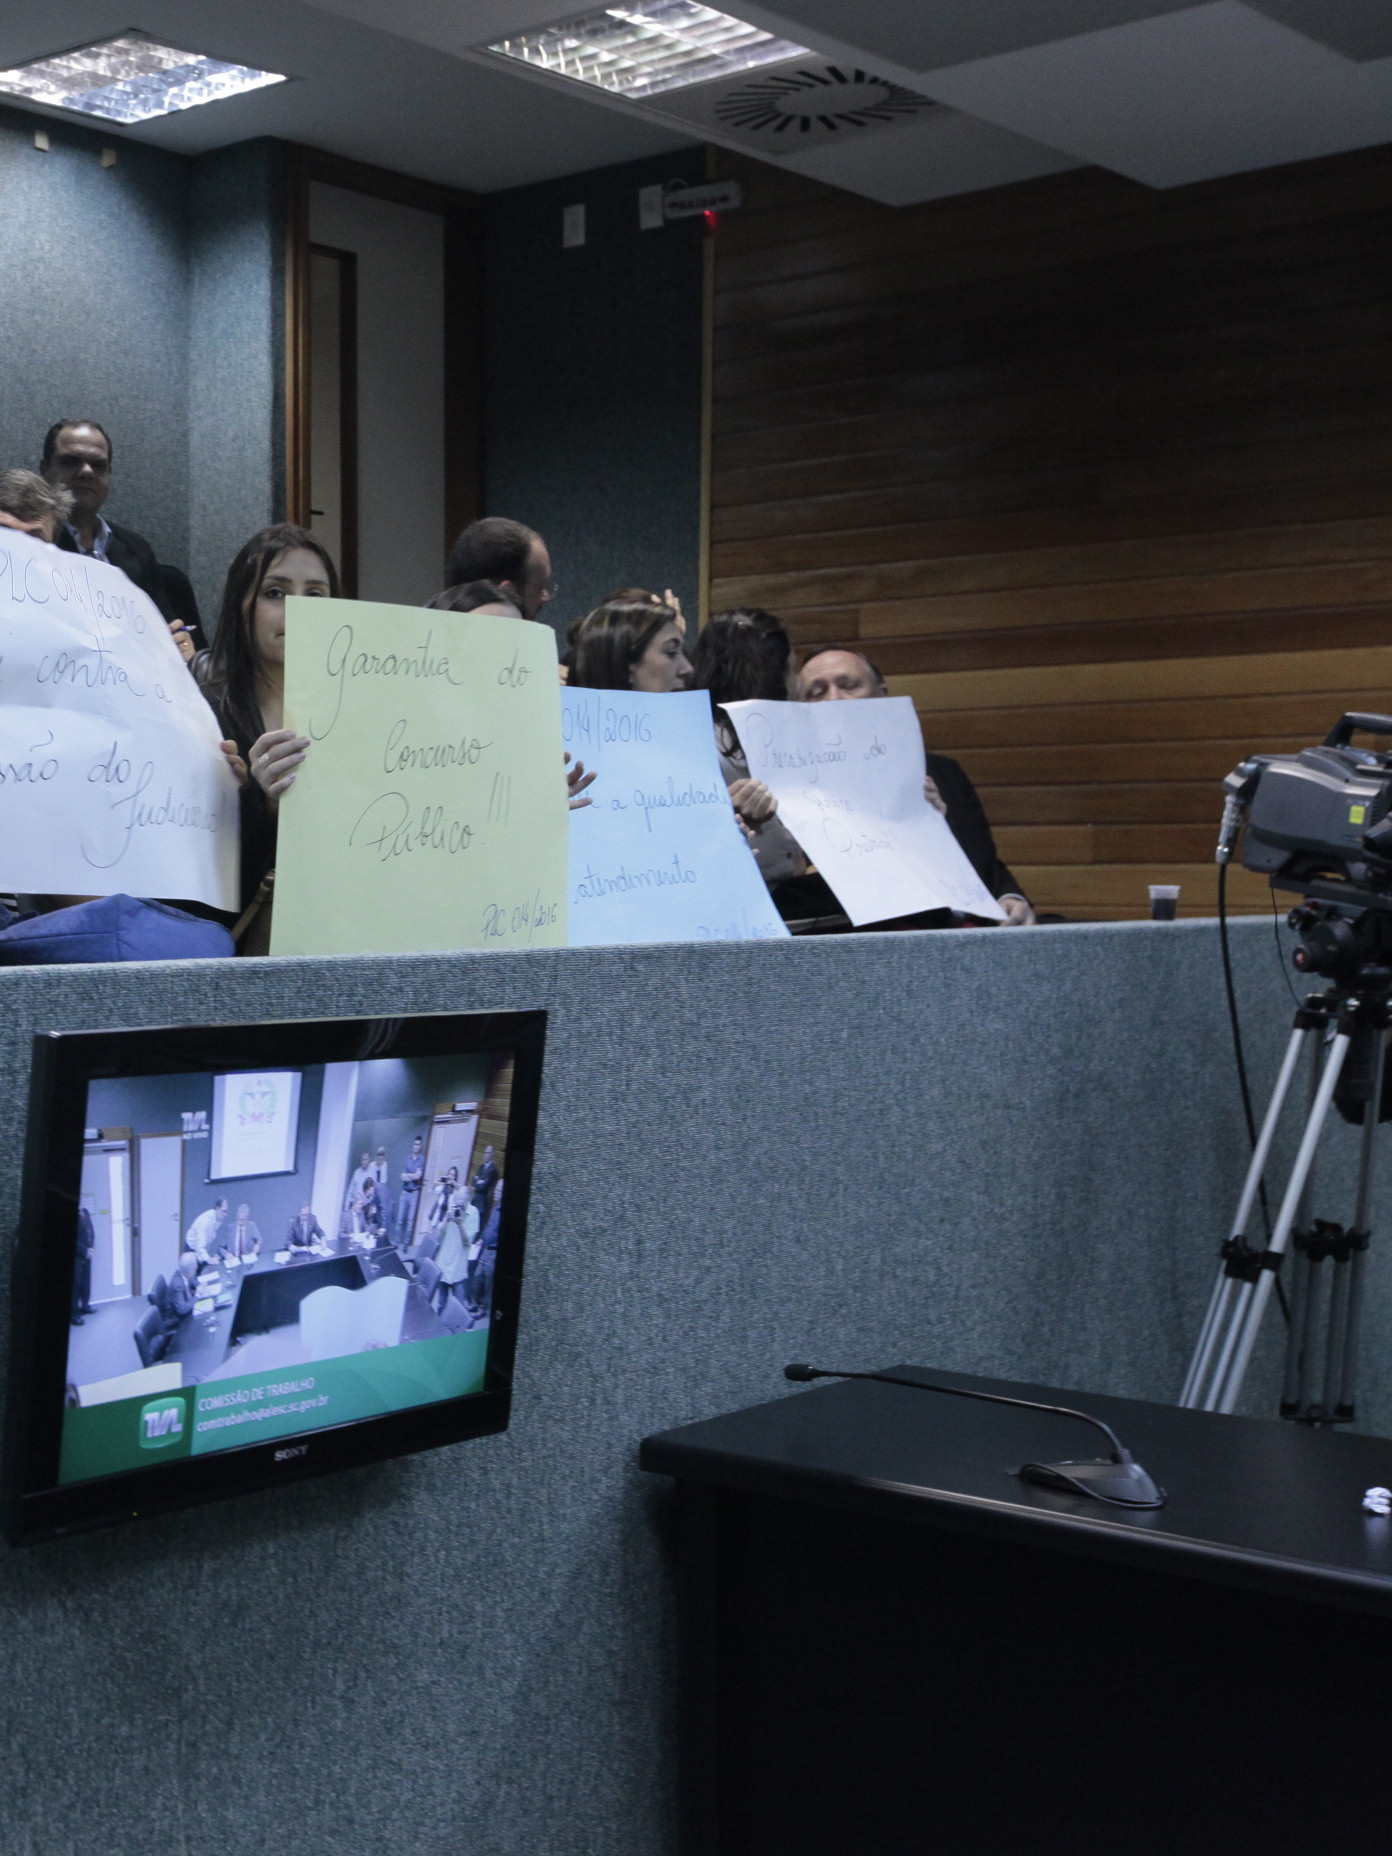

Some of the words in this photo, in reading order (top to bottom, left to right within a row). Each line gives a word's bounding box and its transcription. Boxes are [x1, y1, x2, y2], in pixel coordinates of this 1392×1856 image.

[35, 634, 146, 698] contra
[309, 624, 465, 741] Garantia
[496, 648, 534, 688] do
[86, 740, 133, 786] do
[382, 718, 494, 774] Concurso
[198, 1389, 250, 1412] COMISSÃO
[251, 1386, 264, 1400] DE
[266, 1377, 316, 1398] TRABALHO
[274, 1444, 309, 1462] SONY
